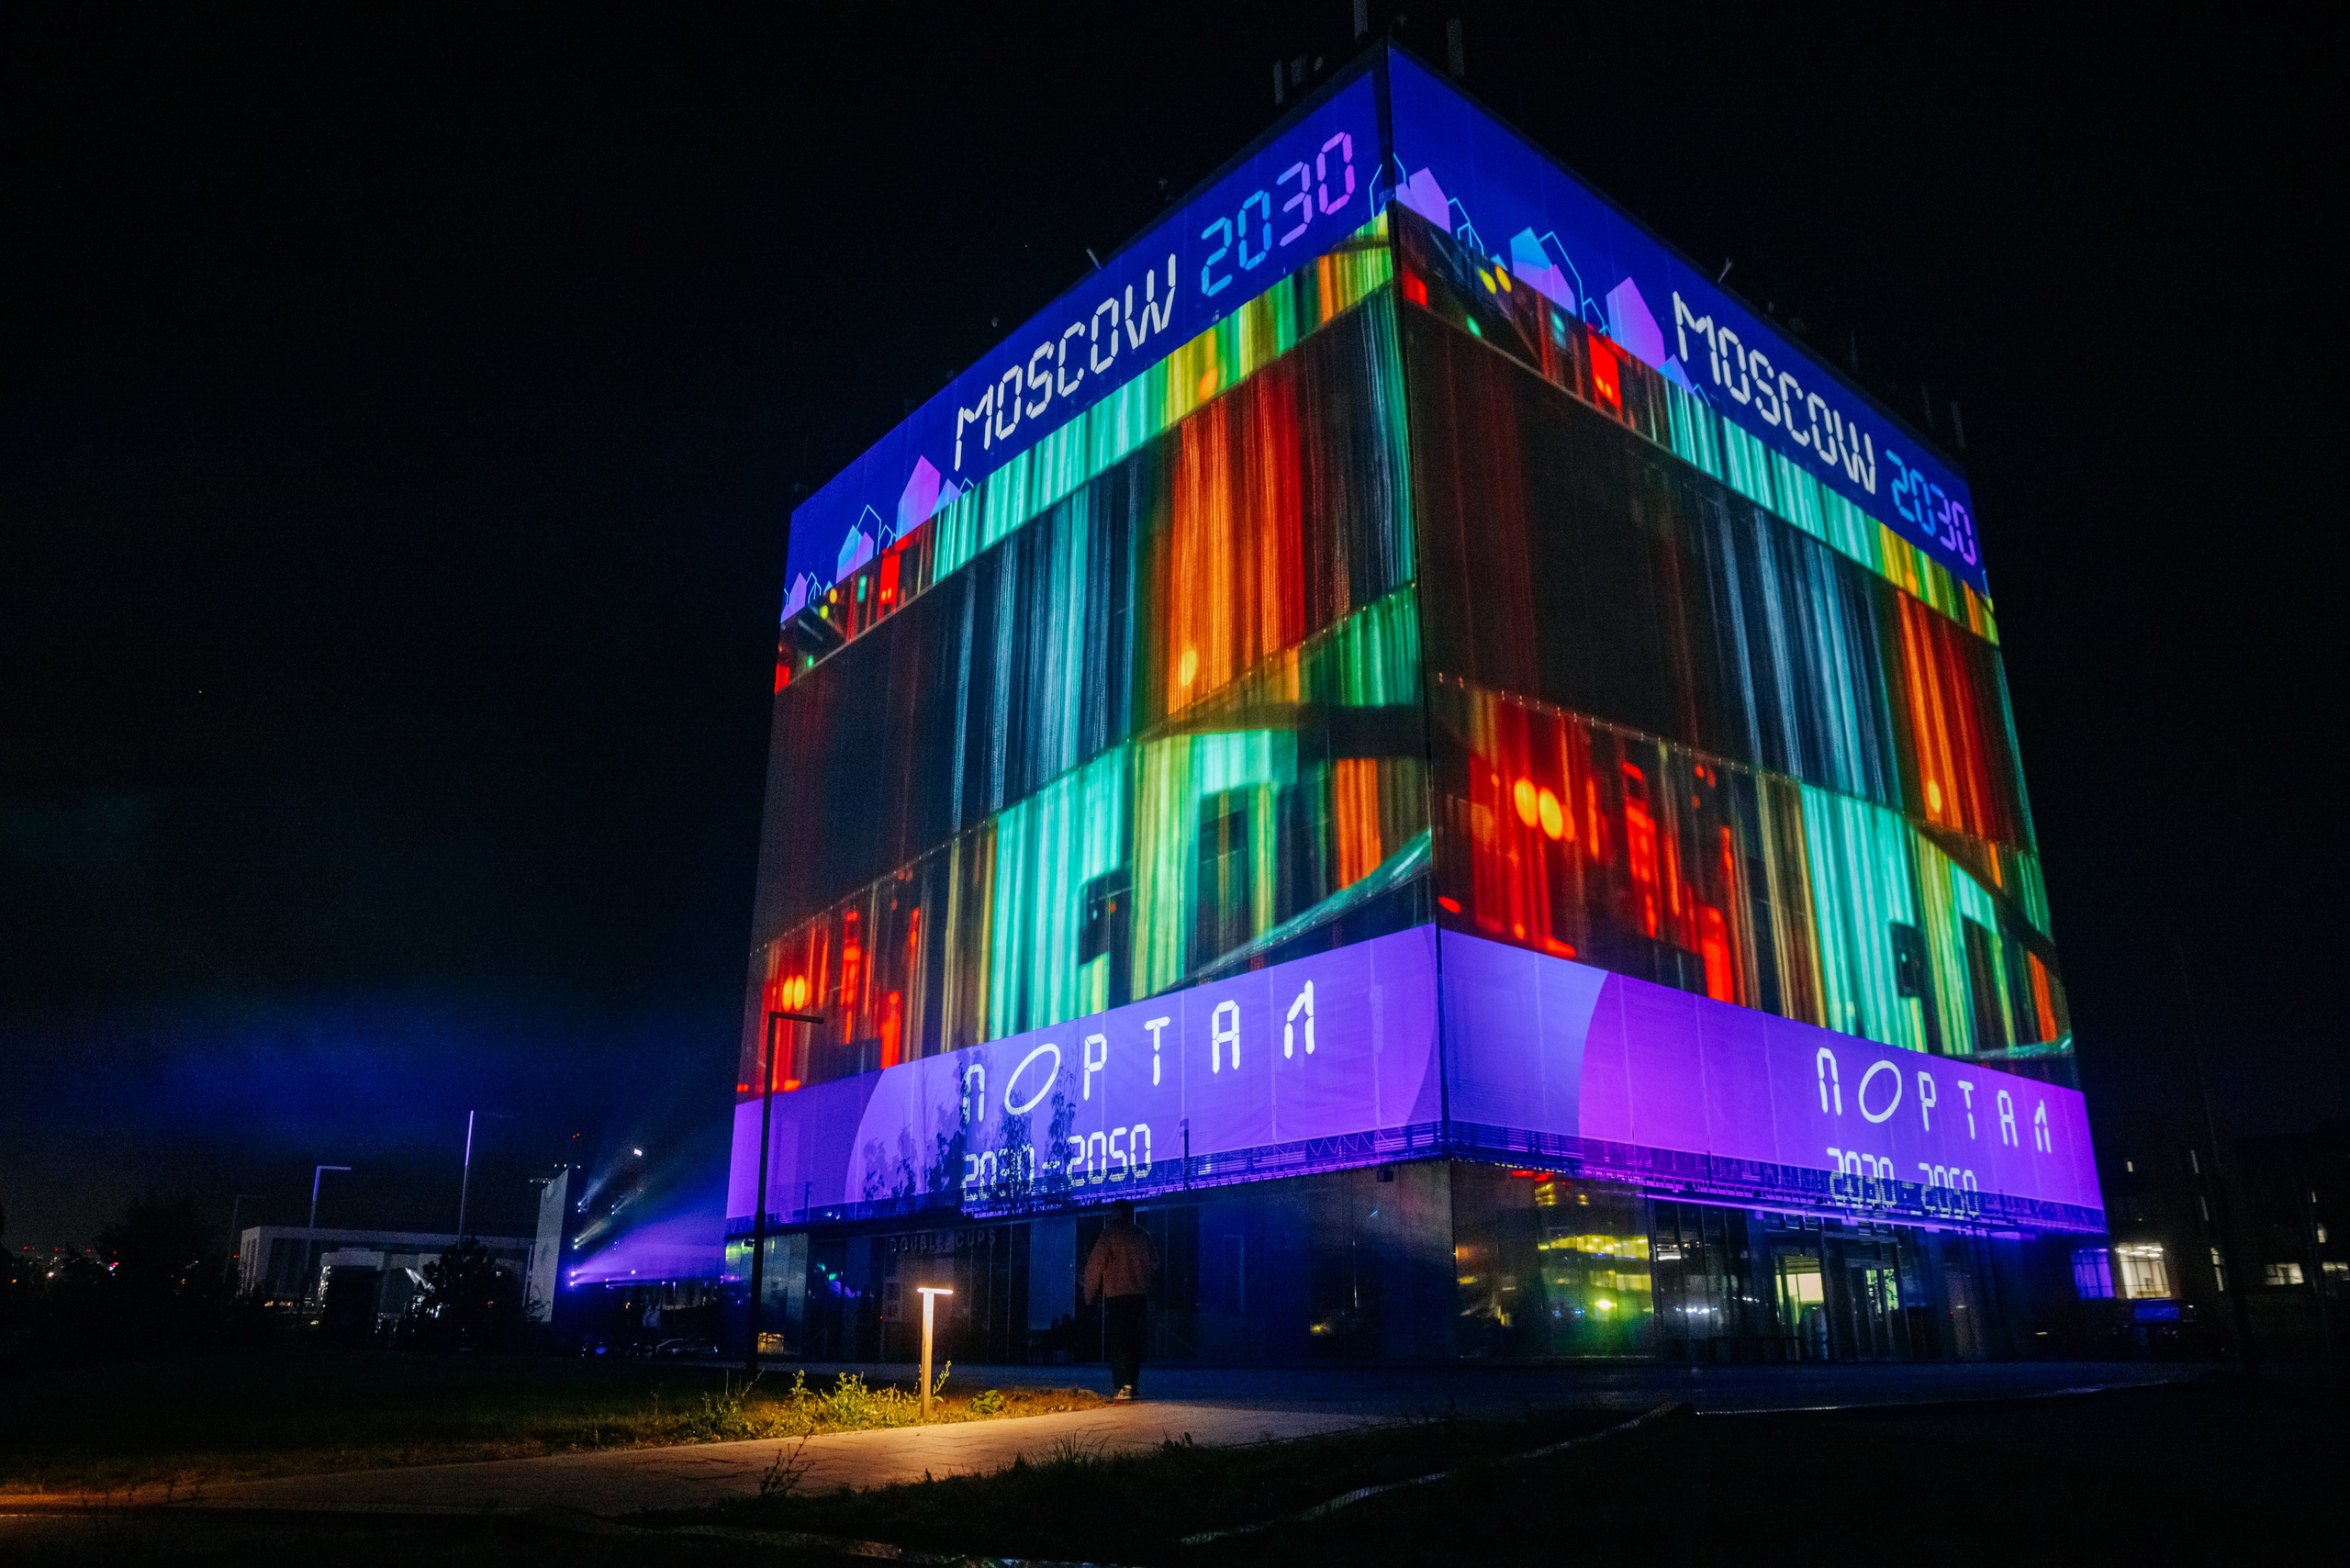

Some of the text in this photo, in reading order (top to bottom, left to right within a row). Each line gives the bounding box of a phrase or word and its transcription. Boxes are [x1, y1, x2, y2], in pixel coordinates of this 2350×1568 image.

[955, 131, 1356, 472] MOSCOW 2030
[1673, 291, 1976, 566] MOSCOW 2030
[890, 1228, 996, 1253] DOUBLE CUPS
